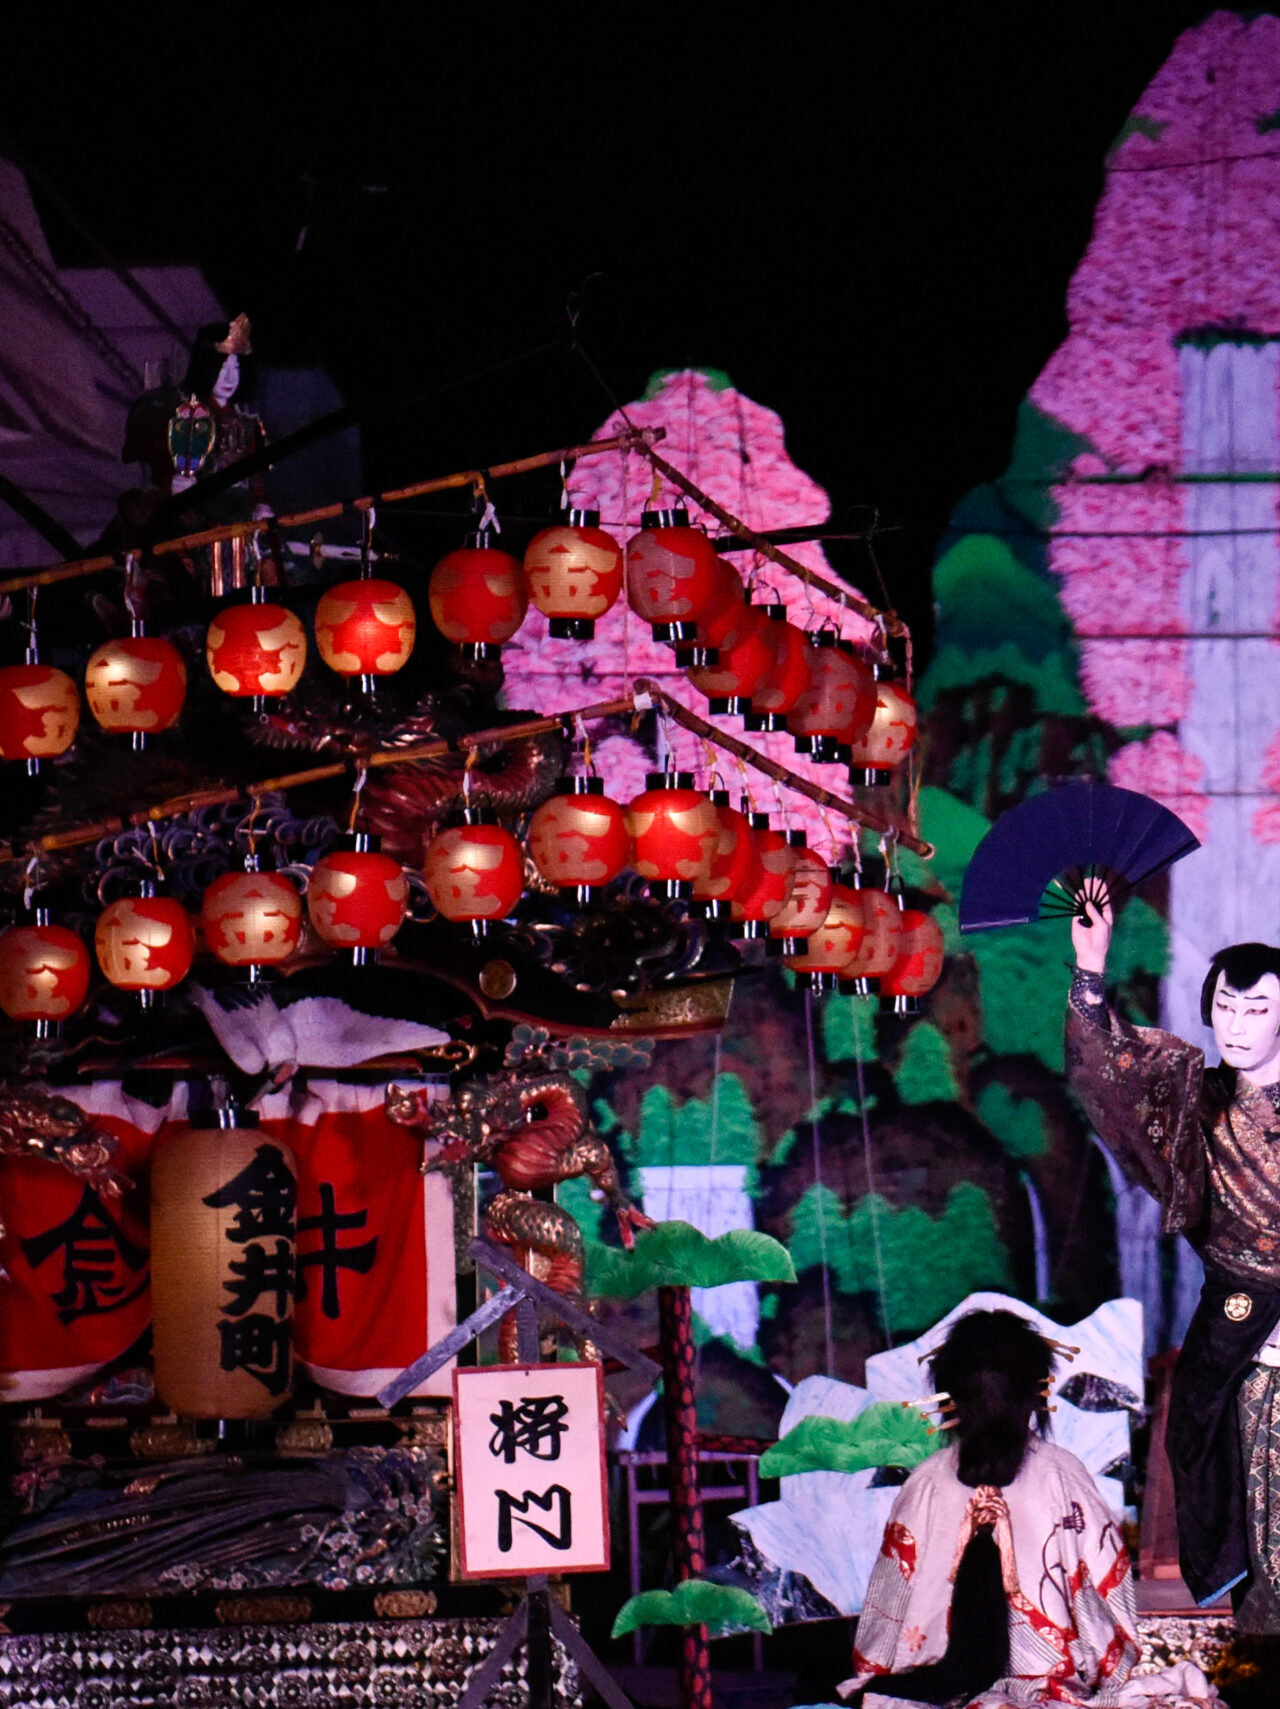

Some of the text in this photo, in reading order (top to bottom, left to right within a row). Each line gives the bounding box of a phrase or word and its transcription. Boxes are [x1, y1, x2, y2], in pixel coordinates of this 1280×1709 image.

[525, 528, 617, 615] 金
[203, 873, 300, 963] 金
[203, 1143, 297, 1396] 金井町
